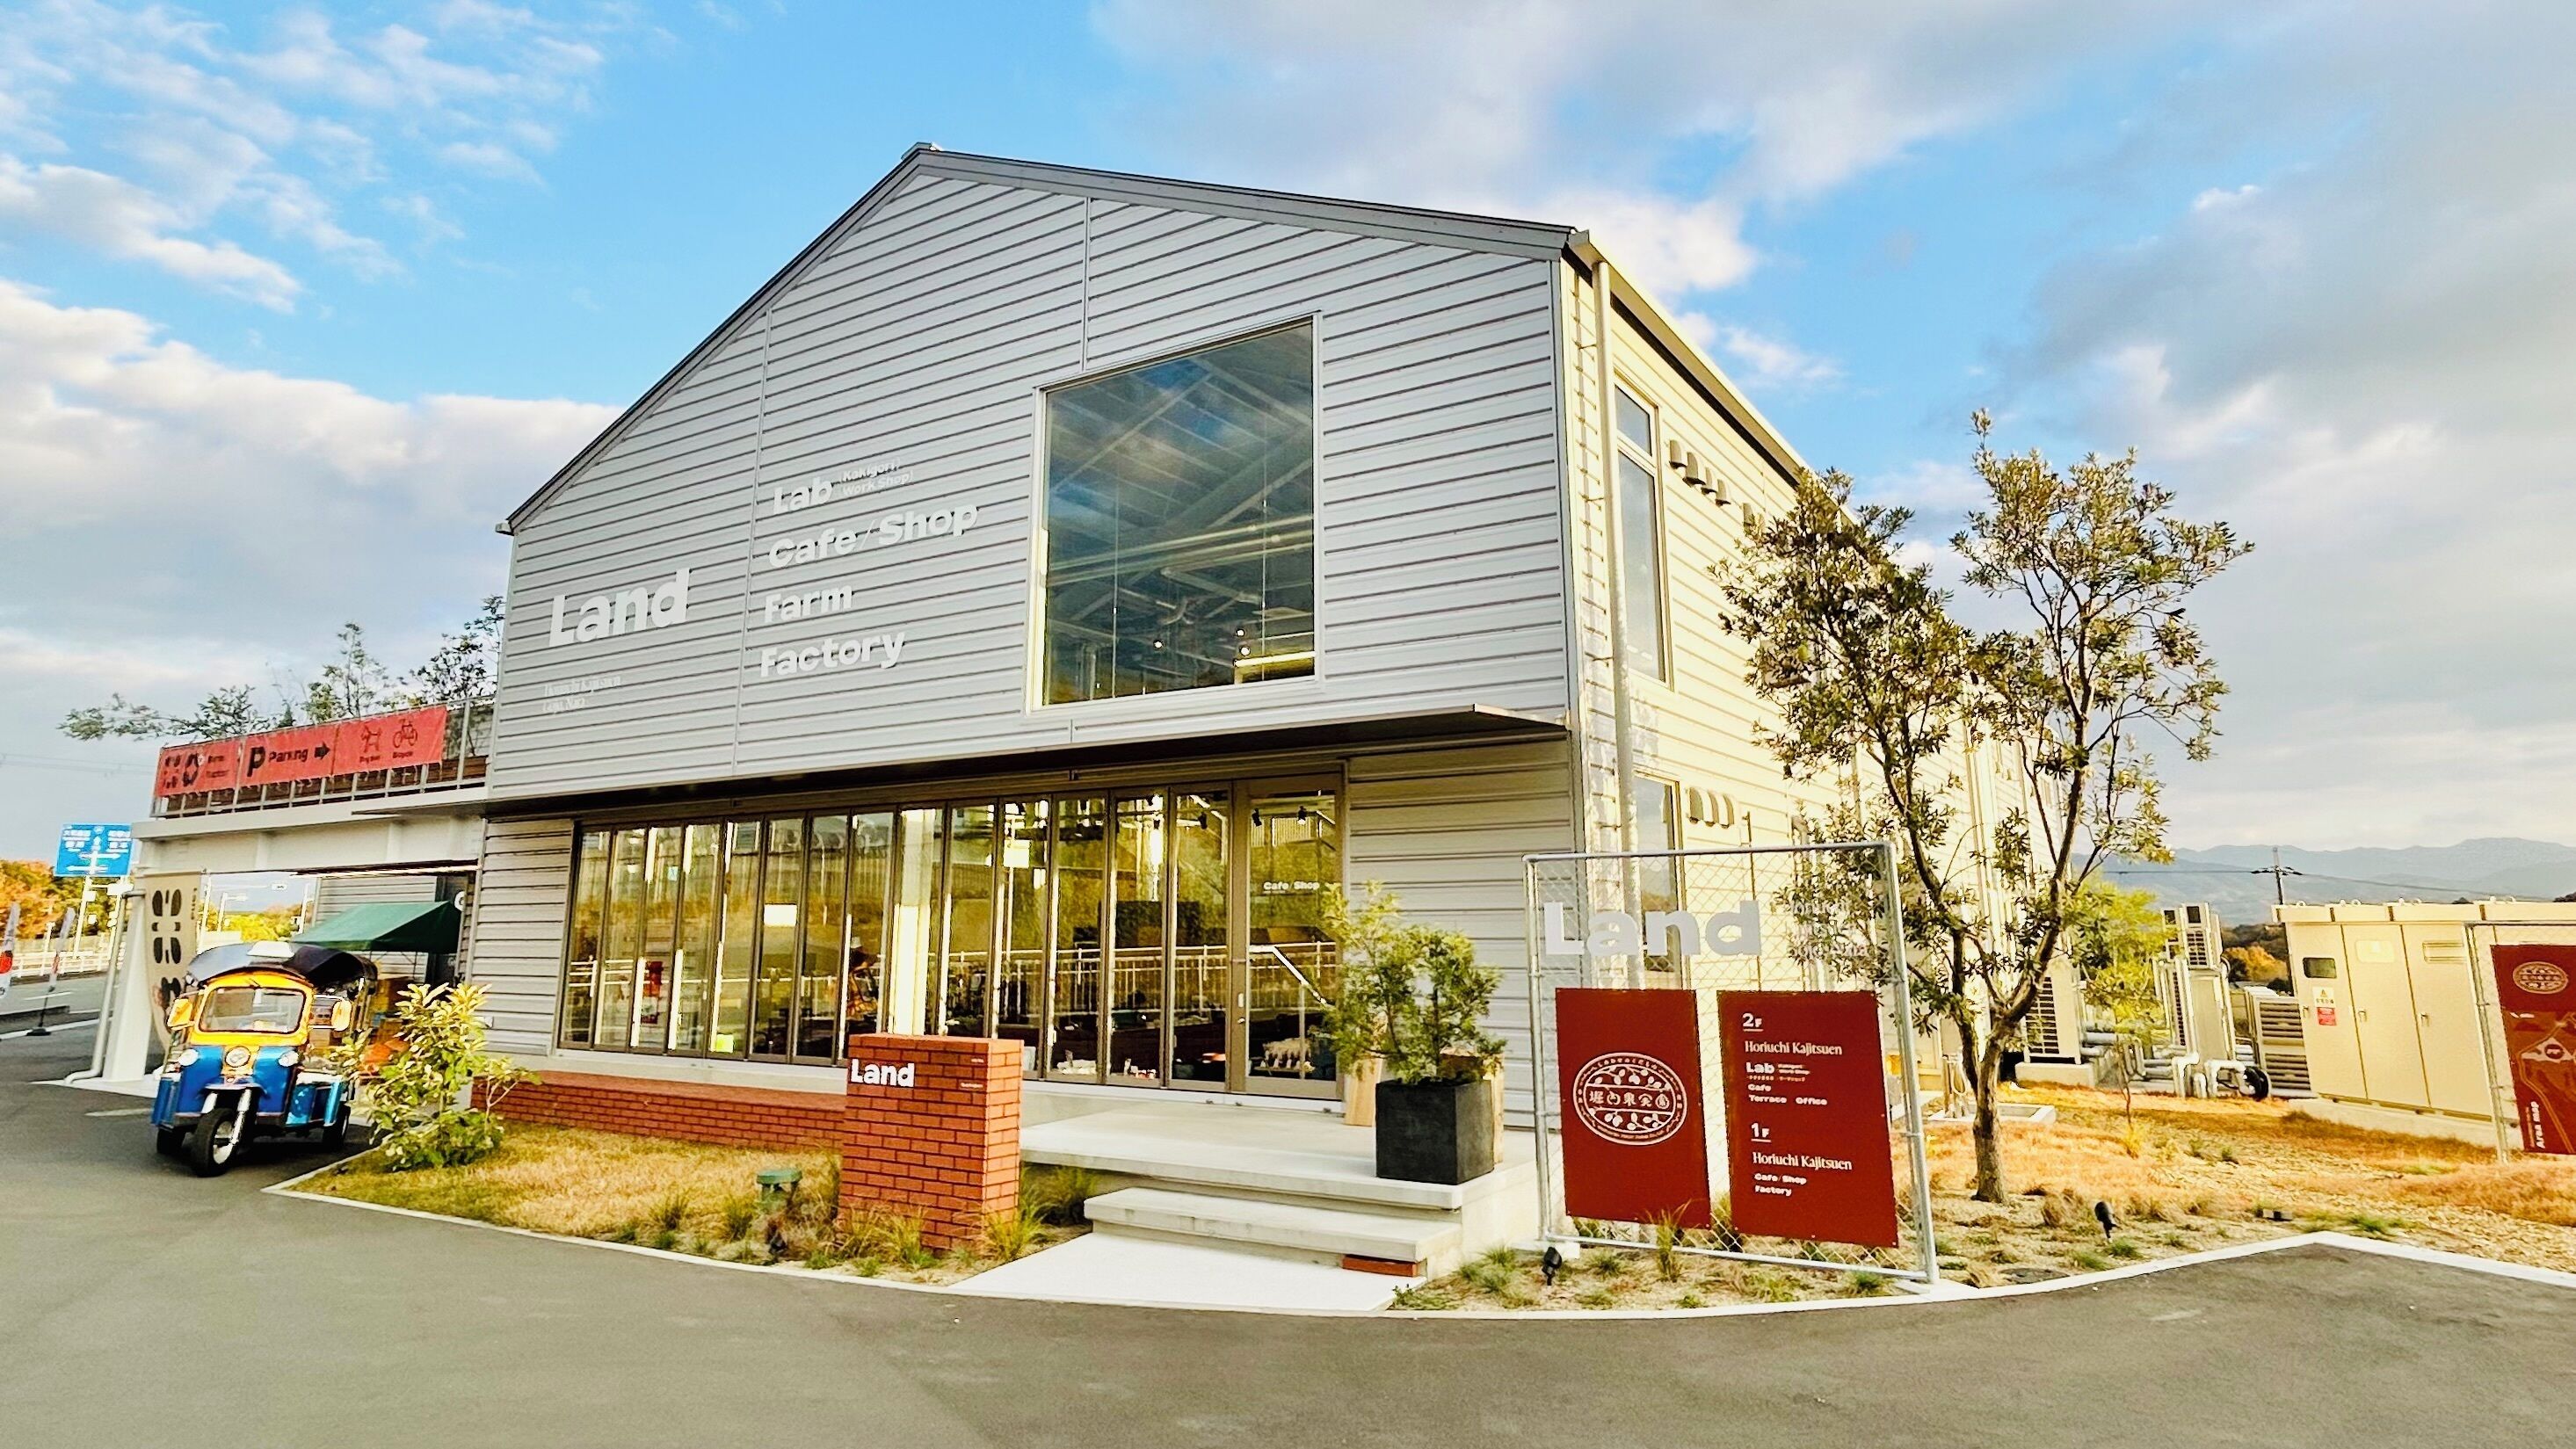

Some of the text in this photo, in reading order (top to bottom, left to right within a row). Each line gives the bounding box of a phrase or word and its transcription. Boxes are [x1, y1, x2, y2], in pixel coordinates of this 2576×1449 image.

[773, 476, 833, 515] Lab
[549, 568, 690, 647] Land
[764, 585, 853, 623] Farm
[760, 632, 904, 677] Factory
[1543, 900, 1761, 956] Land
[1742, 1012, 1763, 1028] 2F
[1745, 1040, 1843, 1056] Horiuchi Kajitsuen
[851, 1059, 915, 1088] Land
[1745, 1061, 1775, 1074] Lab
[1747, 1083, 1772, 1092] Cafe
[1795, 1097, 1828, 1105] Office
[1751, 1122, 1770, 1138] 1F
[1752, 1151, 1853, 1171] Horiuchi Kajitsuen
[1754, 1185, 1792, 1197] Factory
